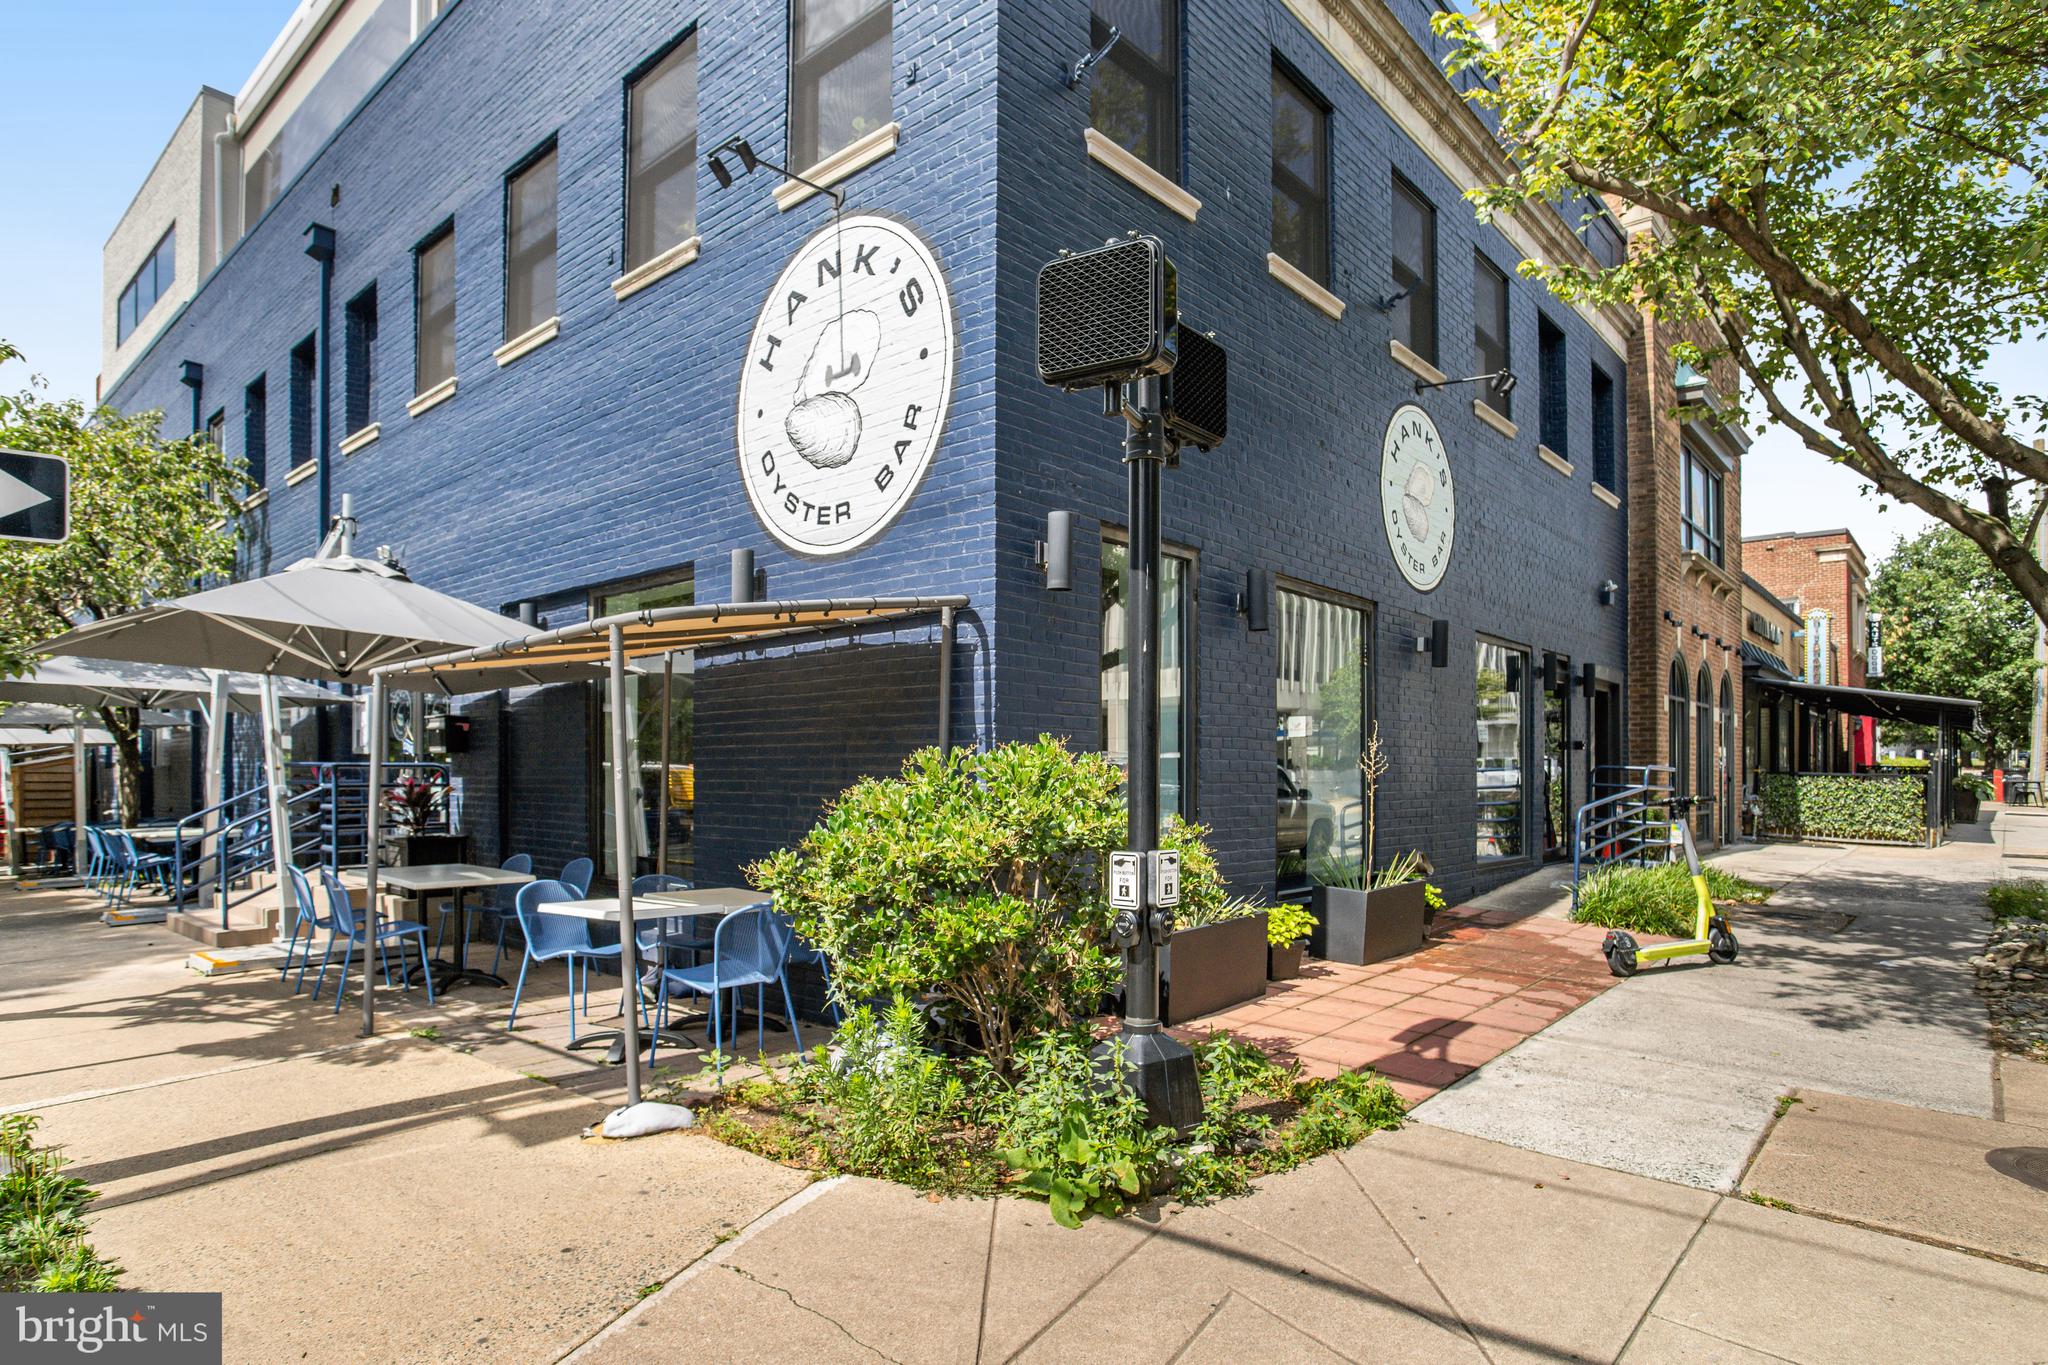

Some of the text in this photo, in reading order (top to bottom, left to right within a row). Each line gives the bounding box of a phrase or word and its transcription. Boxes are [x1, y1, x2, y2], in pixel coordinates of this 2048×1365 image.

[759, 243, 924, 372] HANK'S
[761, 403, 922, 526] OYSTER BAR
[1390, 420, 1447, 488] HANK'S
[1391, 509, 1447, 574] OYSTER BAR
